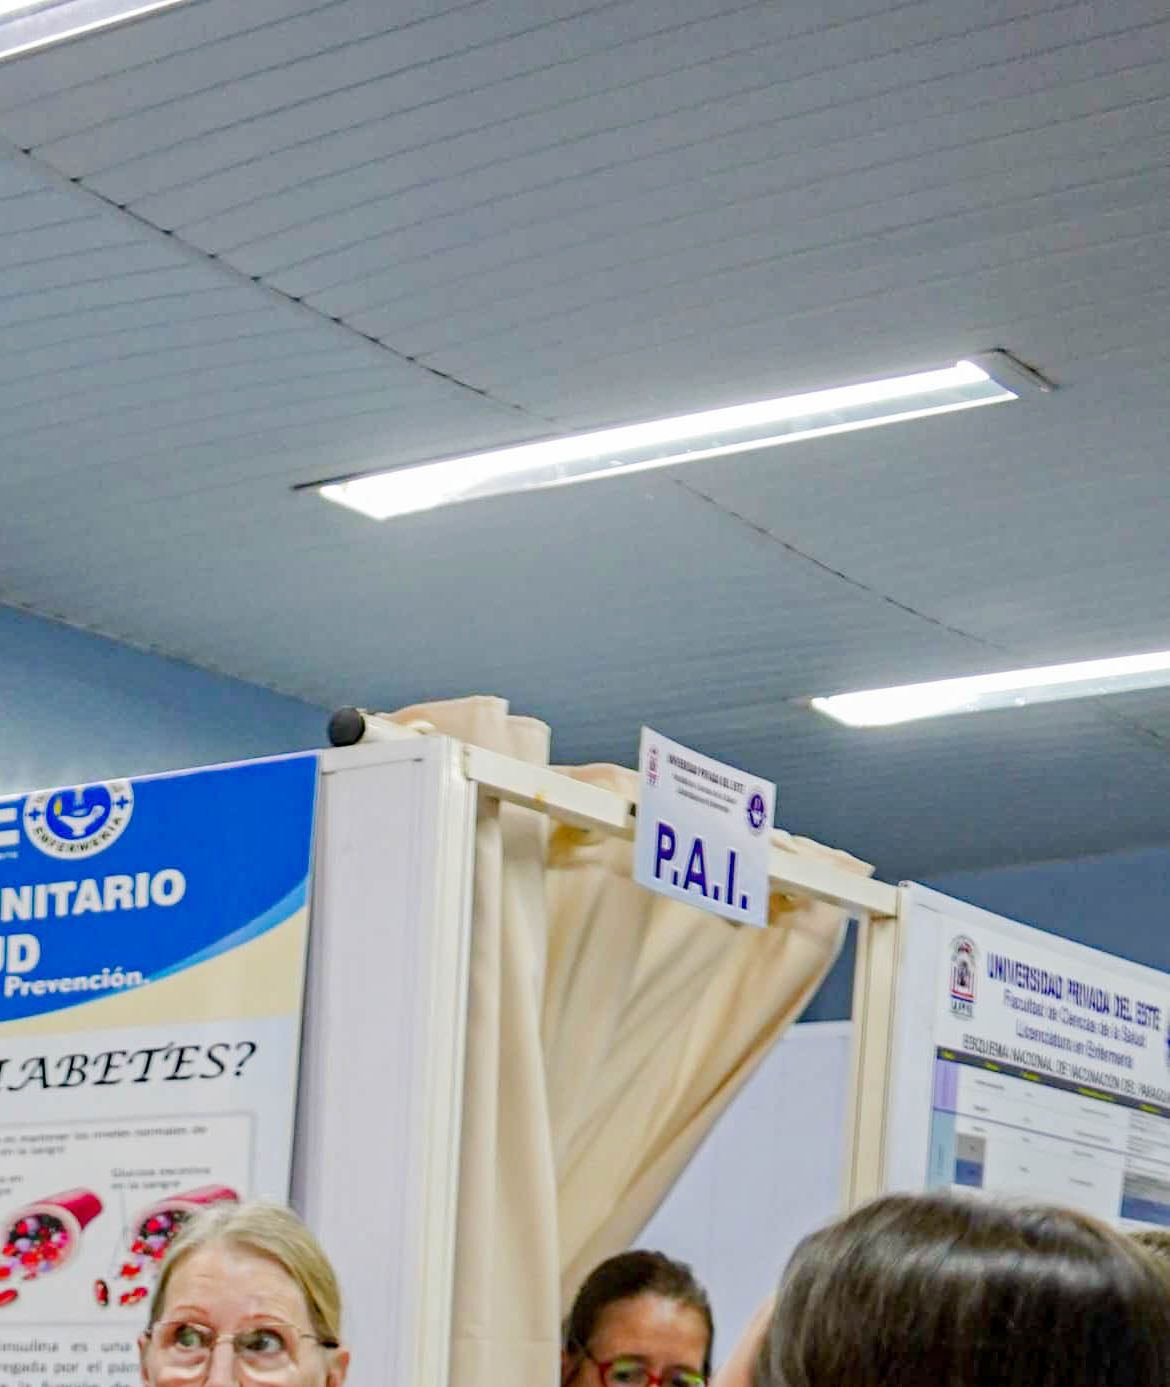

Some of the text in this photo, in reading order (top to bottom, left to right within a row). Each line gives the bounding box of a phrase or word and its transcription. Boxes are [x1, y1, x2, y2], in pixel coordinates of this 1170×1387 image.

[655, 821, 748, 911] P.A.I.
[4, 967, 151, 999] Prevención.
[987, 951, 1161, 1031] UNIVERSIDAD PRIVADA DEL ESTE
[0, 1339, 59, 1353] insulina
[100, 1342, 132, 1353] una
[52, 1363, 79, 1375] por
[86, 1360, 103, 1373] el
